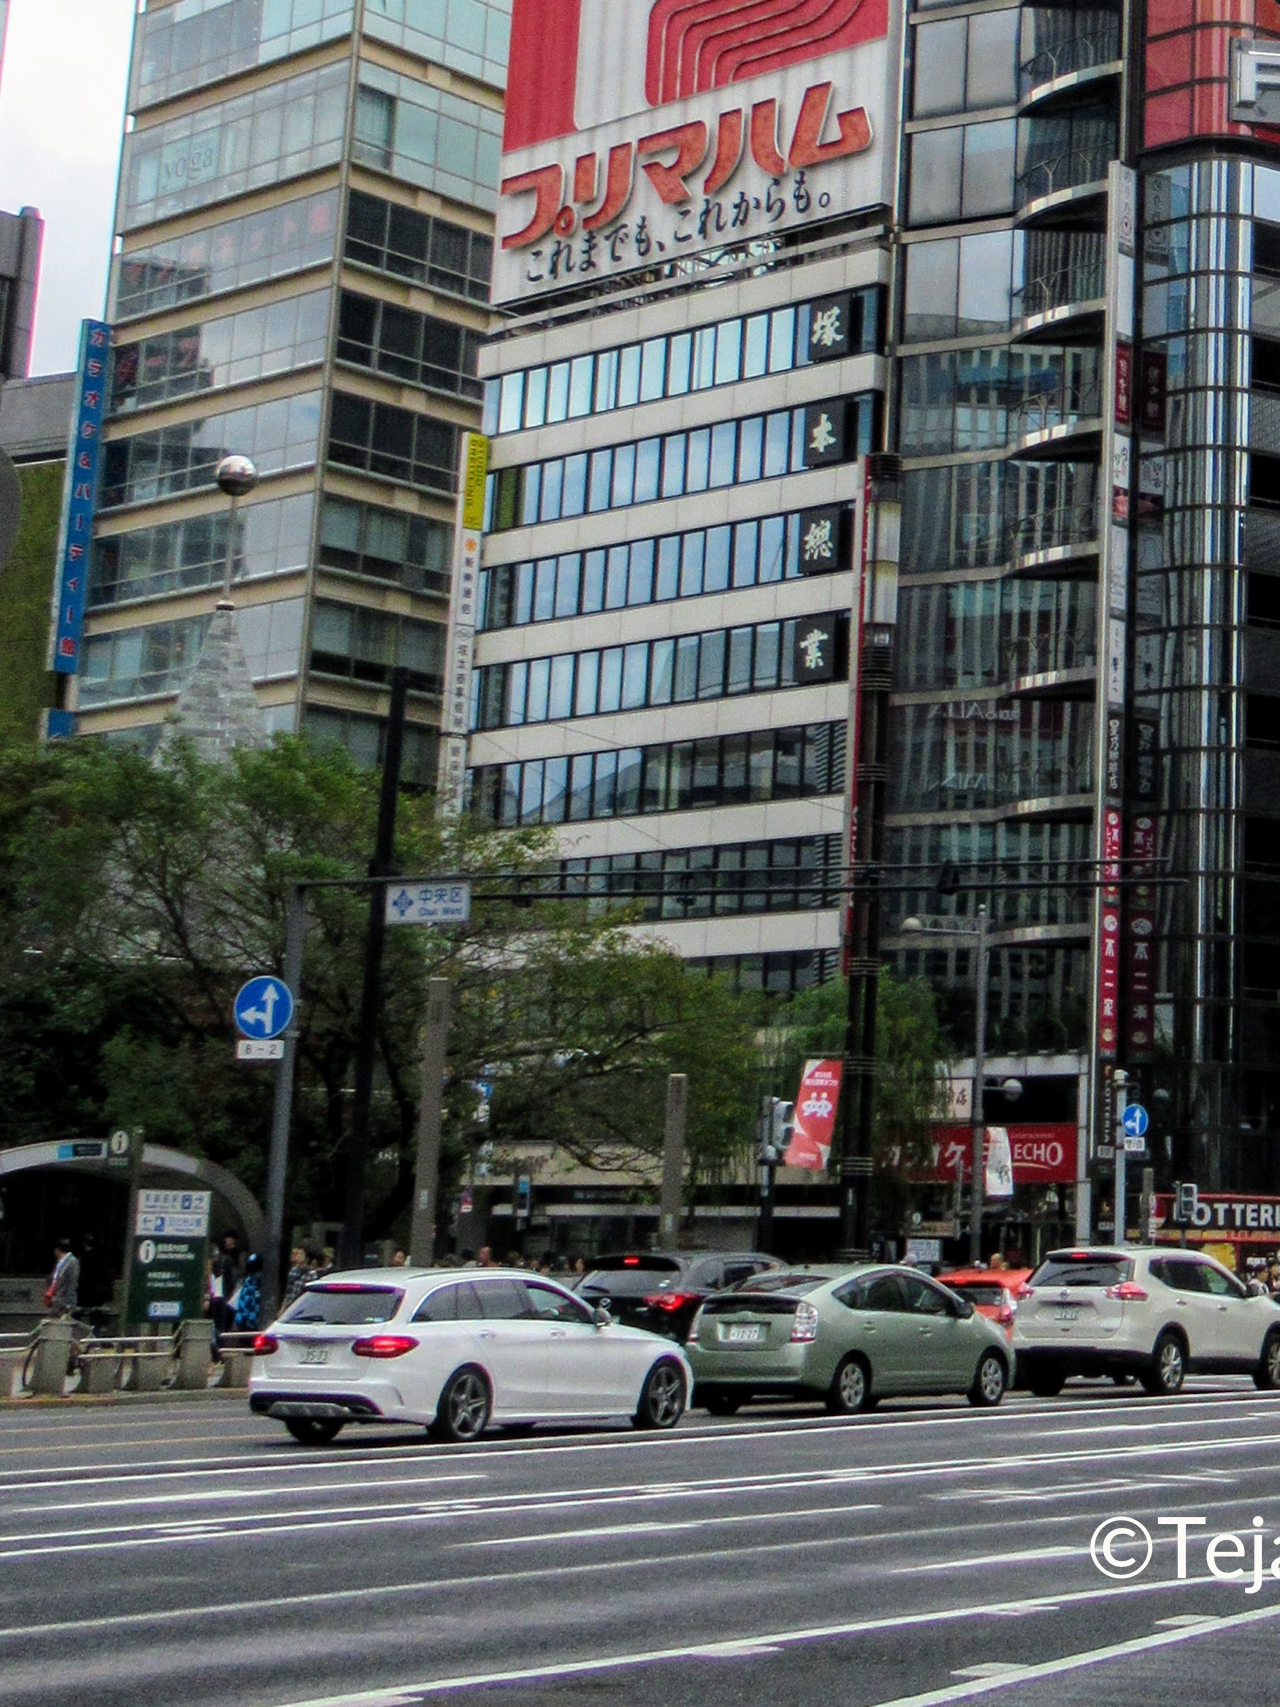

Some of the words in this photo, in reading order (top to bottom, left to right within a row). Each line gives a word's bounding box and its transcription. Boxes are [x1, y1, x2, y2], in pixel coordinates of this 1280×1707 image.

[501, 81, 874, 250] プリマハム
[526, 171, 831, 283] これまでも、これからも。
[419, 887, 463, 904] 中央区
[1104, 938, 1116, 1017] 不二家
[1013, 1141, 1063, 1166] ECHO
